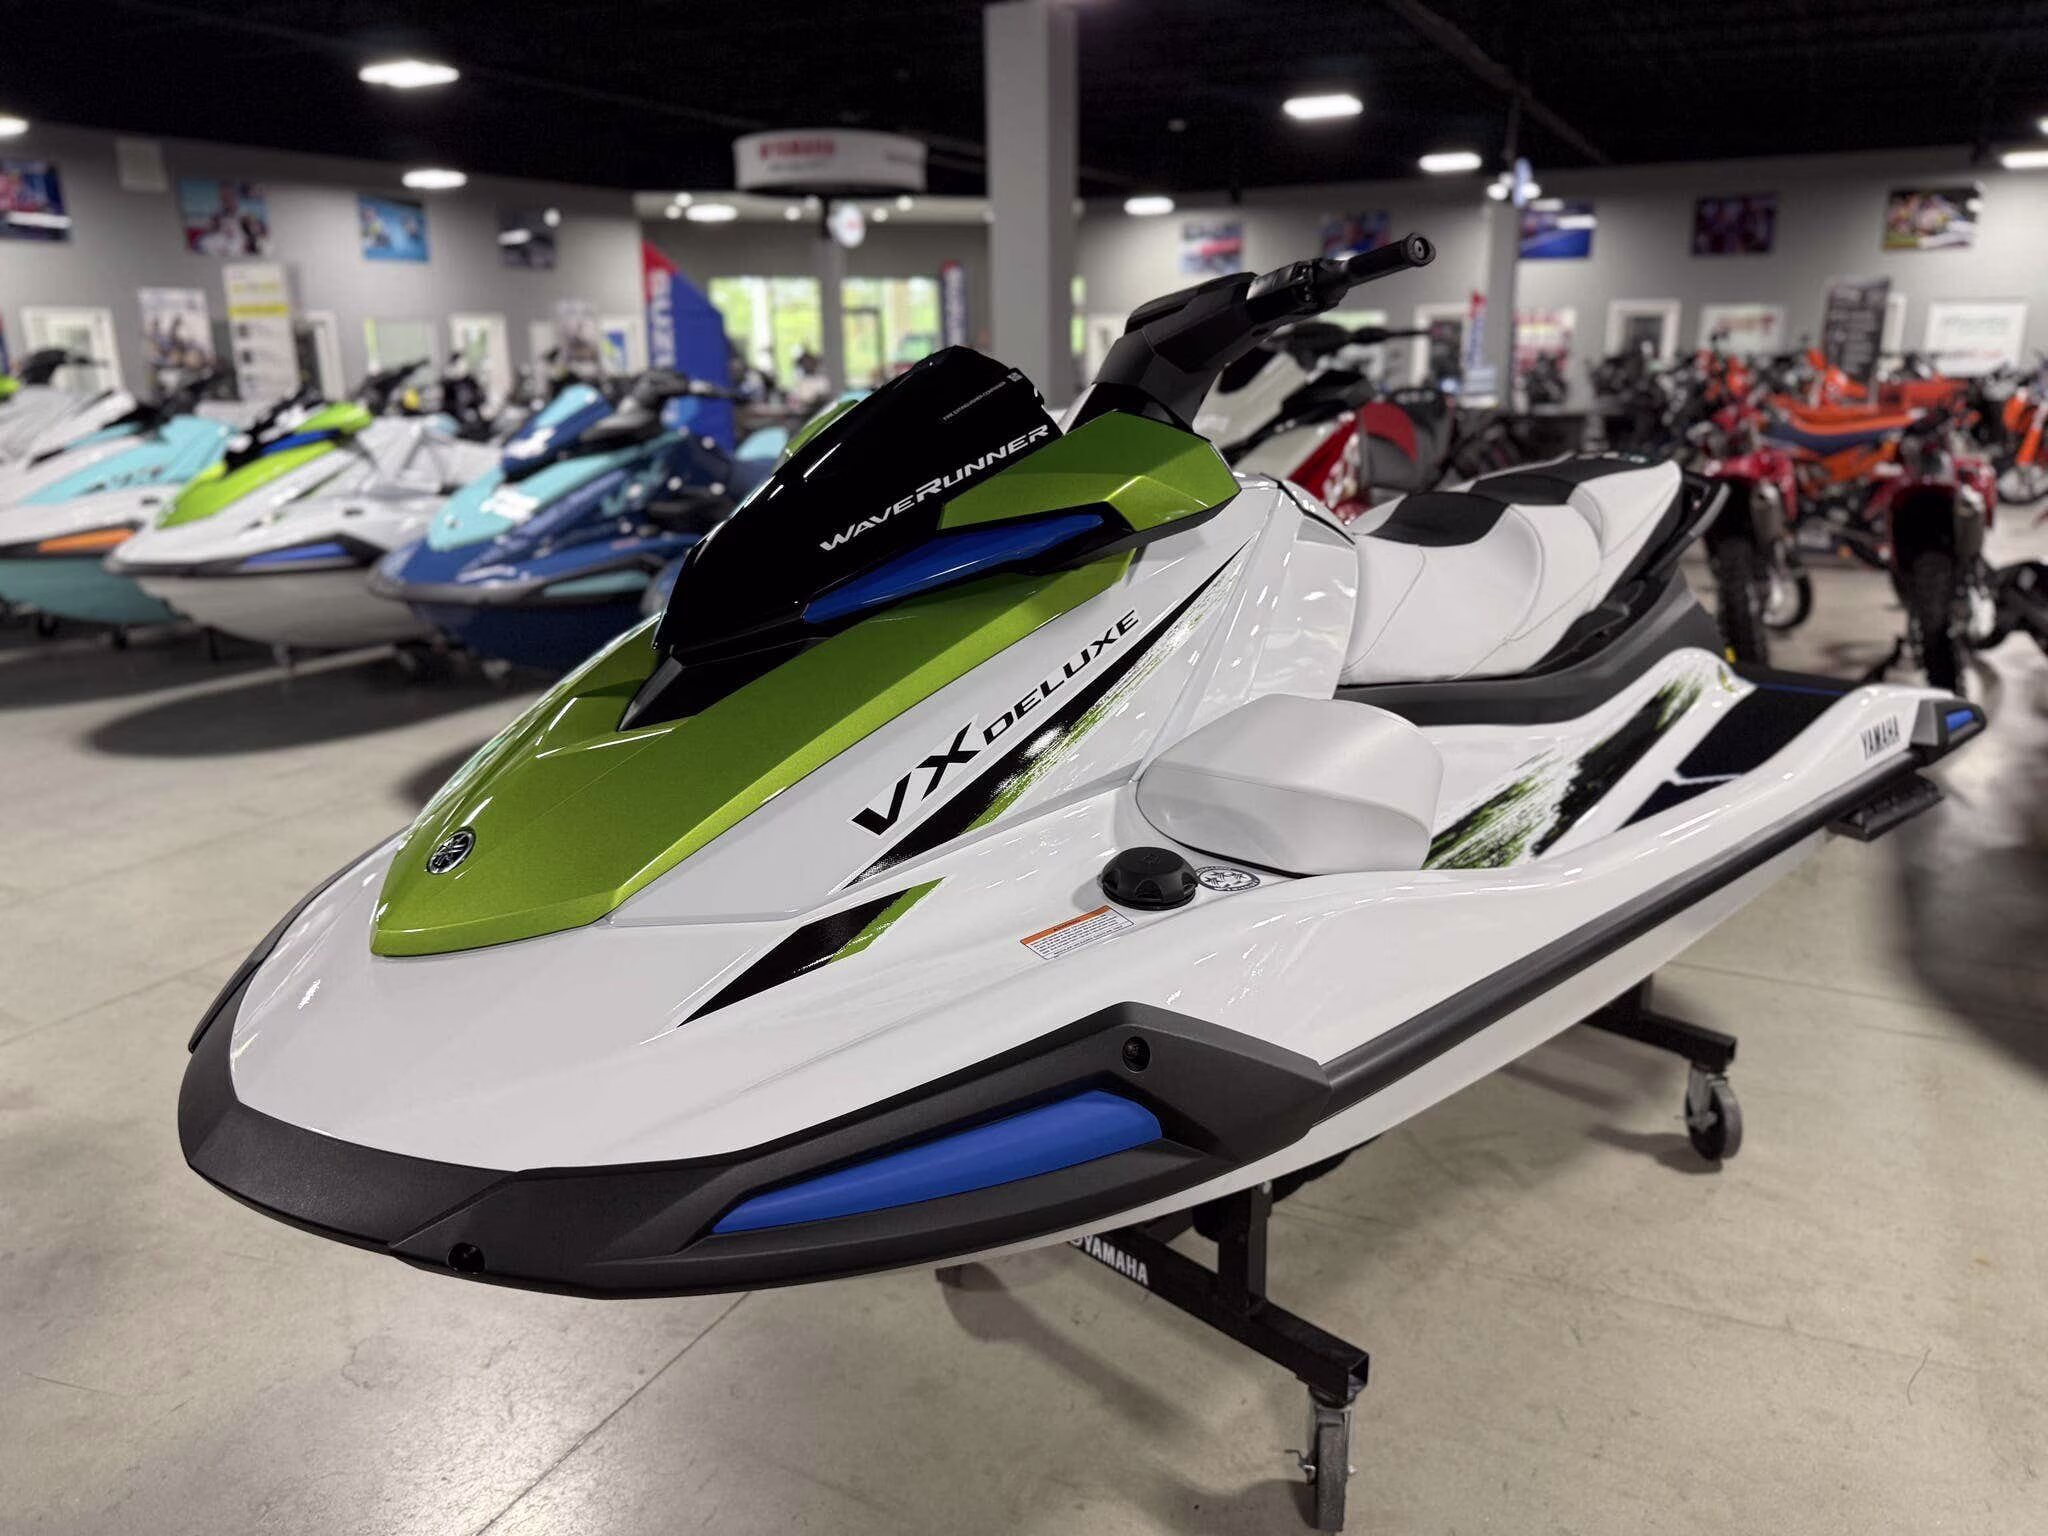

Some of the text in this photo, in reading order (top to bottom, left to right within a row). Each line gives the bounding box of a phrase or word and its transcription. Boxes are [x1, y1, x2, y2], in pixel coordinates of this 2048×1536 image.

[851, 609, 1139, 836] VX DELUXE
[1860, 714, 1900, 760] YAMAHA
[1084, 1234, 1149, 1286] YAMAHA
